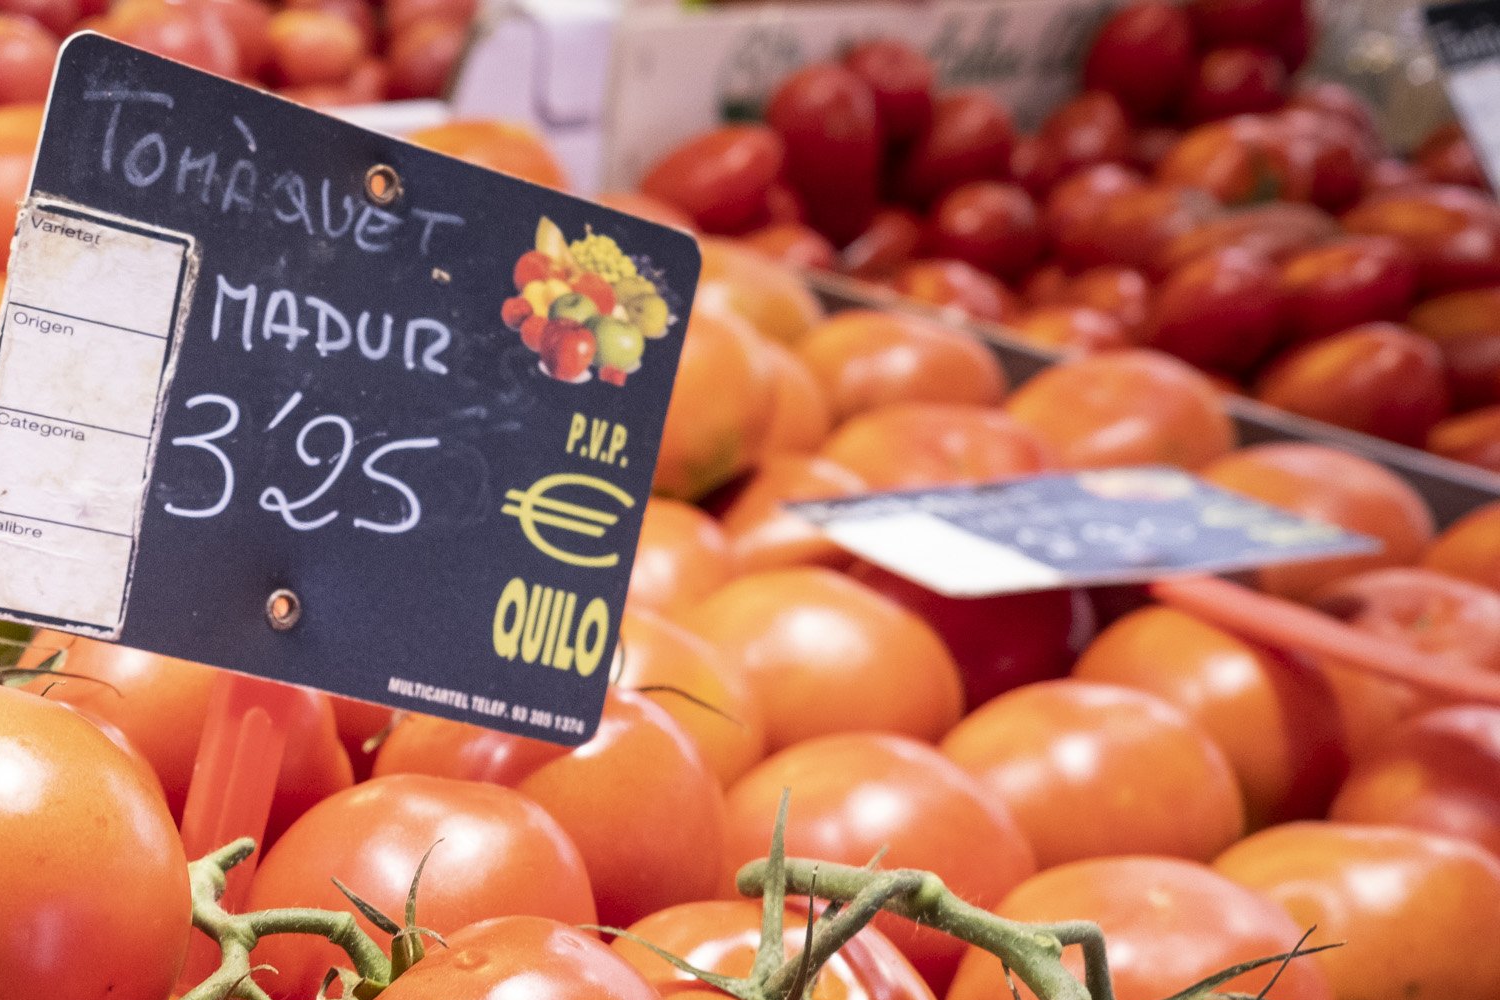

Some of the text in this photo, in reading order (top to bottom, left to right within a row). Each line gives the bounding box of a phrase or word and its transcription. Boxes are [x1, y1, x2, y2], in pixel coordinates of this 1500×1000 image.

[31, 215, 101, 246] Varietat
[13, 311, 75, 337] Origen
[211, 273, 451, 375] MADUR
[163, 390, 441, 534] 3'25
[565, 411, 629, 469] P.V.P.
[492, 577, 610, 678] QUILO
[387, 676, 469, 711] MULTICARTEL
